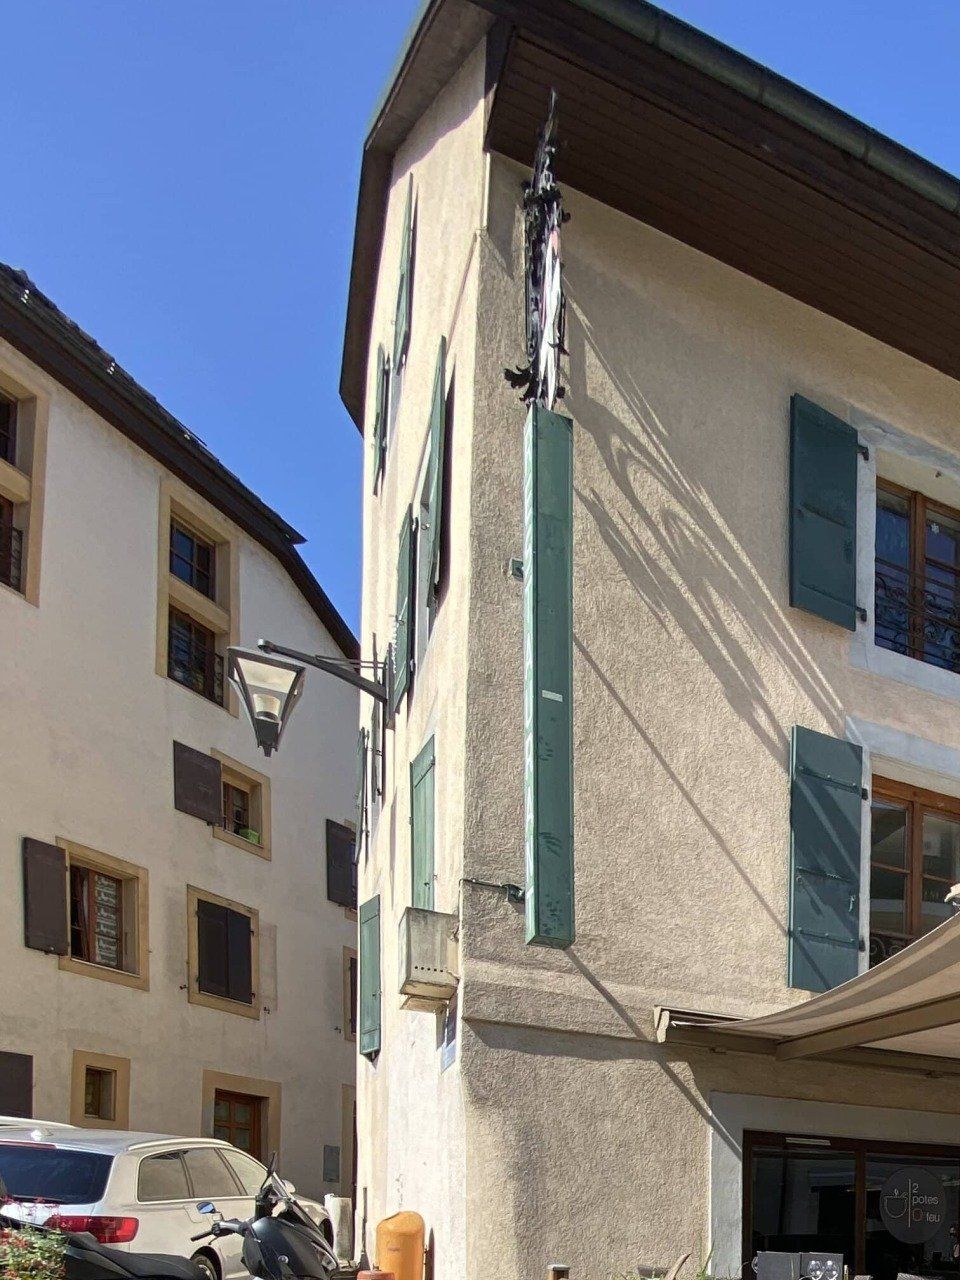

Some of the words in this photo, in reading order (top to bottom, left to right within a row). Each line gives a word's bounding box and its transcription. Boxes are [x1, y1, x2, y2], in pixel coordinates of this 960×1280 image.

[912, 1182, 919, 1193] 2
[912, 1195, 939, 1206] potes
[926, 1211, 940, 1222] feu
